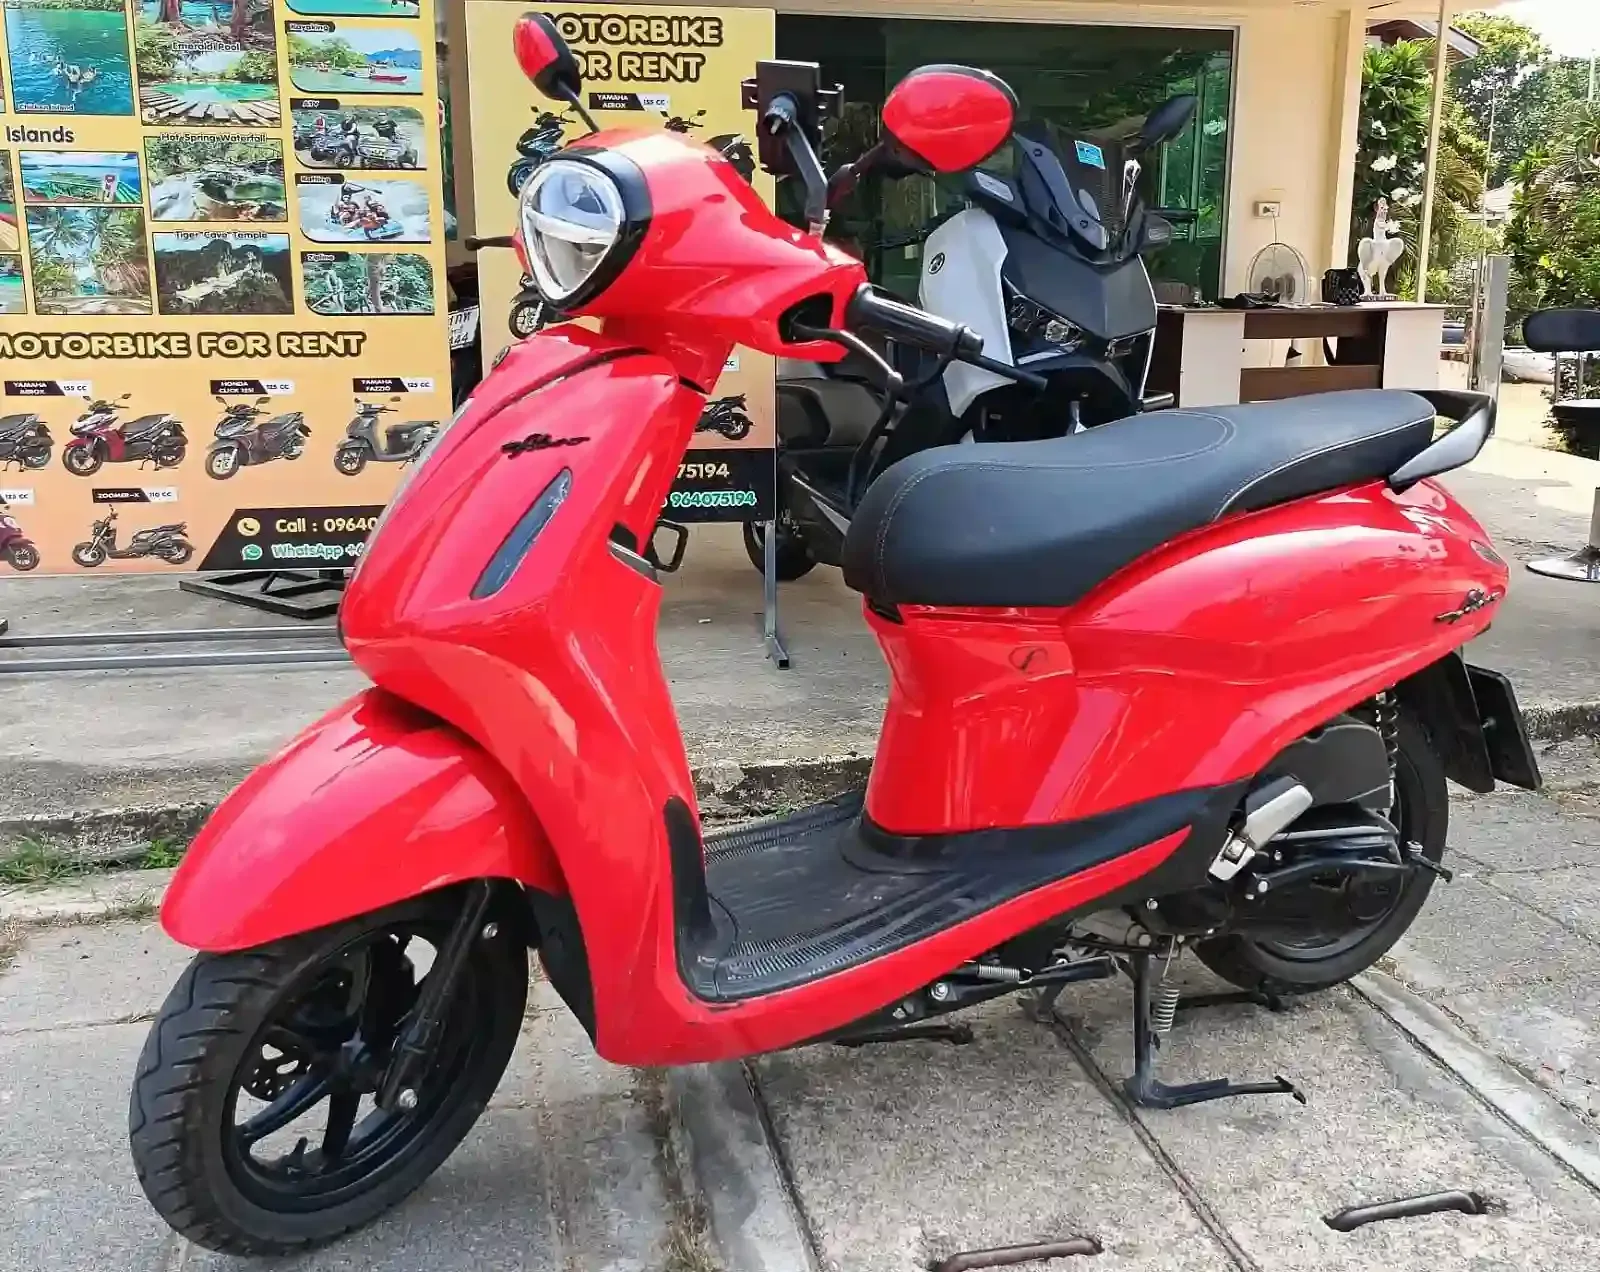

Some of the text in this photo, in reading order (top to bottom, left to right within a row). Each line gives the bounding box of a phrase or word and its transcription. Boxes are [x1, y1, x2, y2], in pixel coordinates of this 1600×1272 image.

[545, 13, 723, 46] OTORBIKE
[172, 42, 241, 51] Emerald Pool
[615, 51, 706, 82] RENT
[6, 124, 75, 143] Islands
[161, 133, 268, 143] Hot Spring Waterfall
[175, 231, 268, 241] Tiger Cave Temple
[198, 332, 272, 358] FOR
[276, 331, 367, 358] RENT
[676, 462, 730, 479] 75194
[670, 491, 757, 508] 964075194
[275, 517, 306, 533] Call
[323, 517, 378, 533] 09640
[271, 542, 344, 560] WhatsApp
